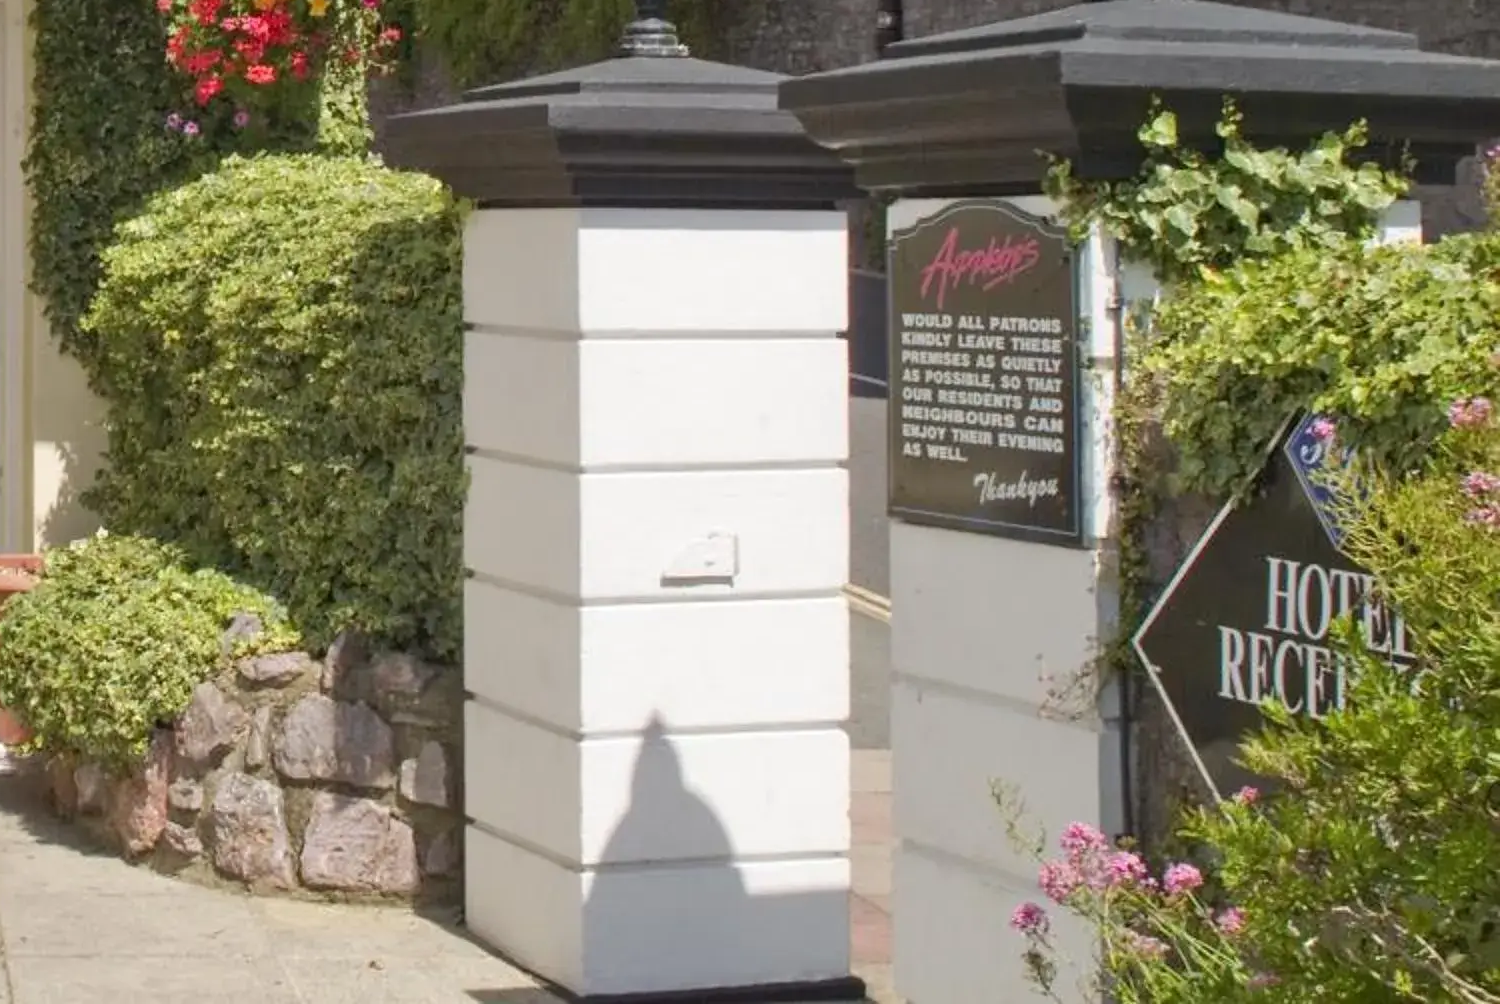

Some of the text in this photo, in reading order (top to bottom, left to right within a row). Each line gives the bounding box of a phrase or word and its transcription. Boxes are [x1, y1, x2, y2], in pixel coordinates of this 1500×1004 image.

[920, 227, 1040, 311] Appleby's
[901, 312, 1062, 333] WOULD ALL PATRONS
[901, 331, 1062, 353] KINDLY LEAVE THESE
[901, 350, 1062, 373] PREMISES AS QUIETLY
[902, 368, 1063, 393] AS POSSIBLE, SO THAT
[902, 387, 1064, 413] OUR RESIDENTS AND
[902, 405, 1064, 433] NEIGHBOURS CAN
[902, 423, 1064, 453] ENJOY THEIR EVENING
[903, 442, 968, 463] AS WELL.
[973, 469, 1060, 509] Thankyou
[1264, 555, 1418, 660] HOTEL
